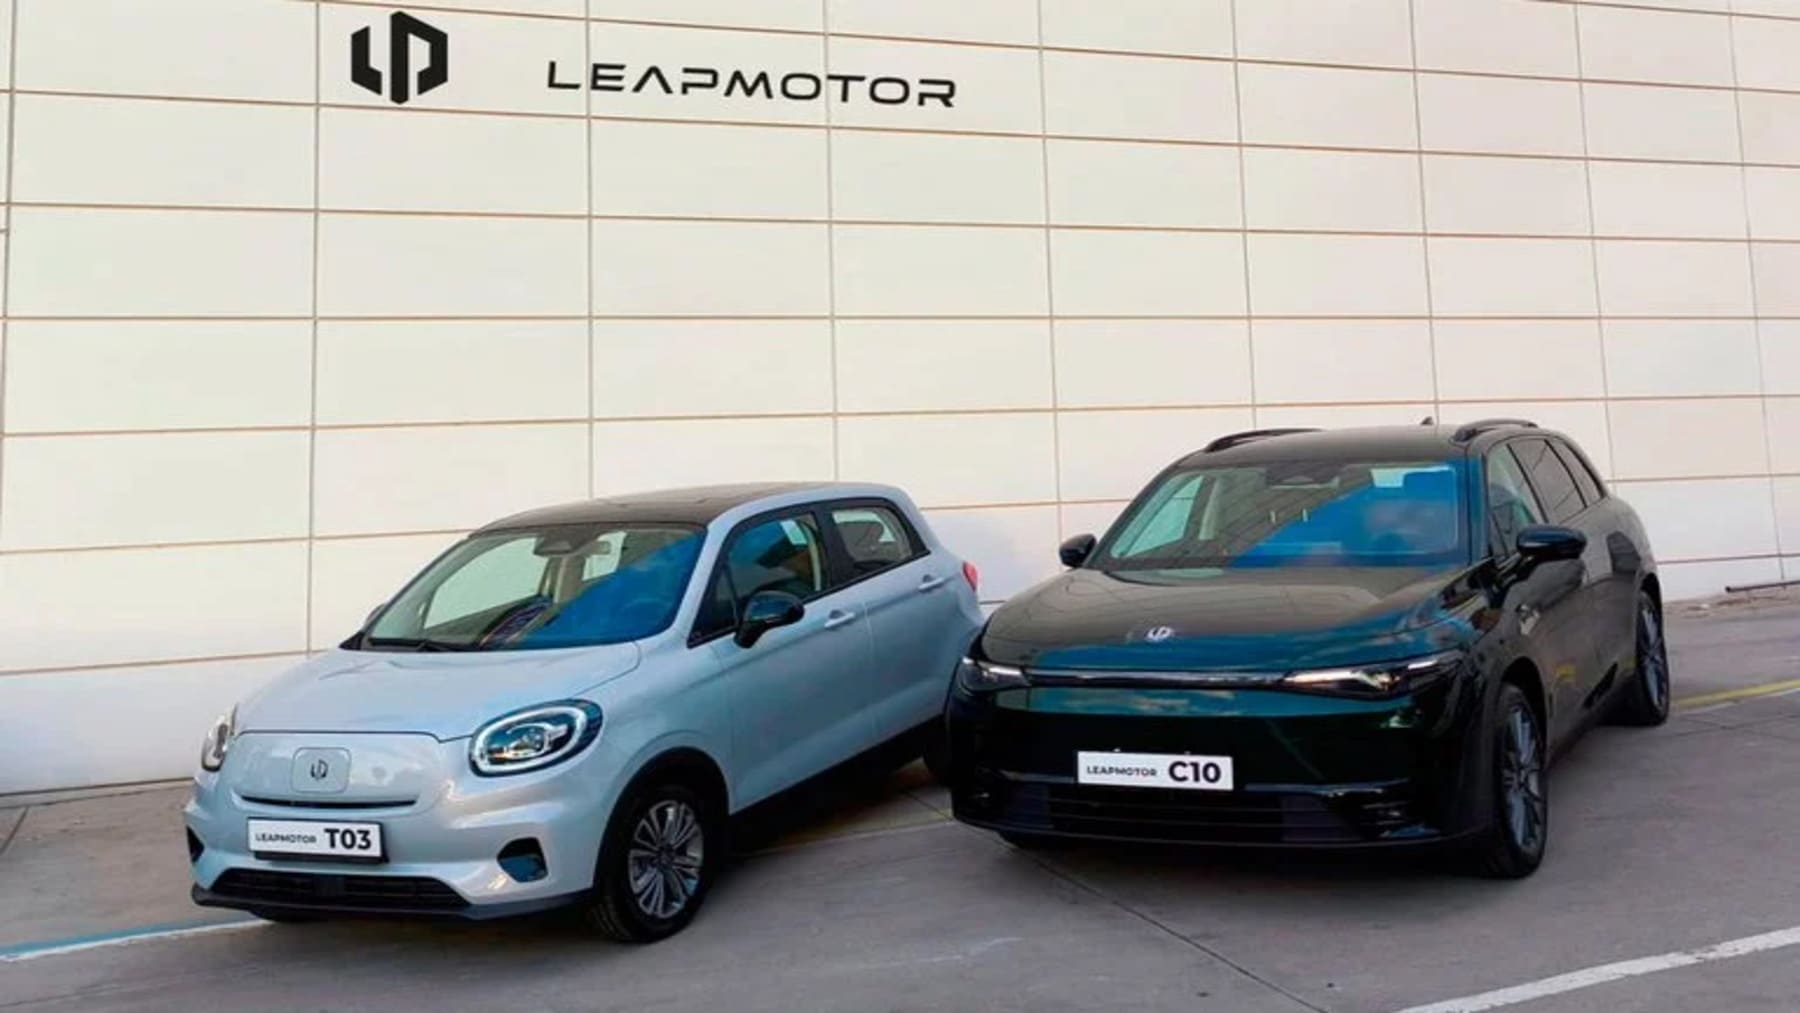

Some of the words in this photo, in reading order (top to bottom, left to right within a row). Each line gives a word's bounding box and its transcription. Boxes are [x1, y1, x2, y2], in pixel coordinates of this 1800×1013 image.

[547, 60, 956, 108] LEAPMOTOR
[1086, 765, 1158, 777] LEAPMOTOR
[1168, 760, 1222, 784] C10
[254, 832, 317, 845] LEAPMOTOR
[323, 827, 372, 850] T03
